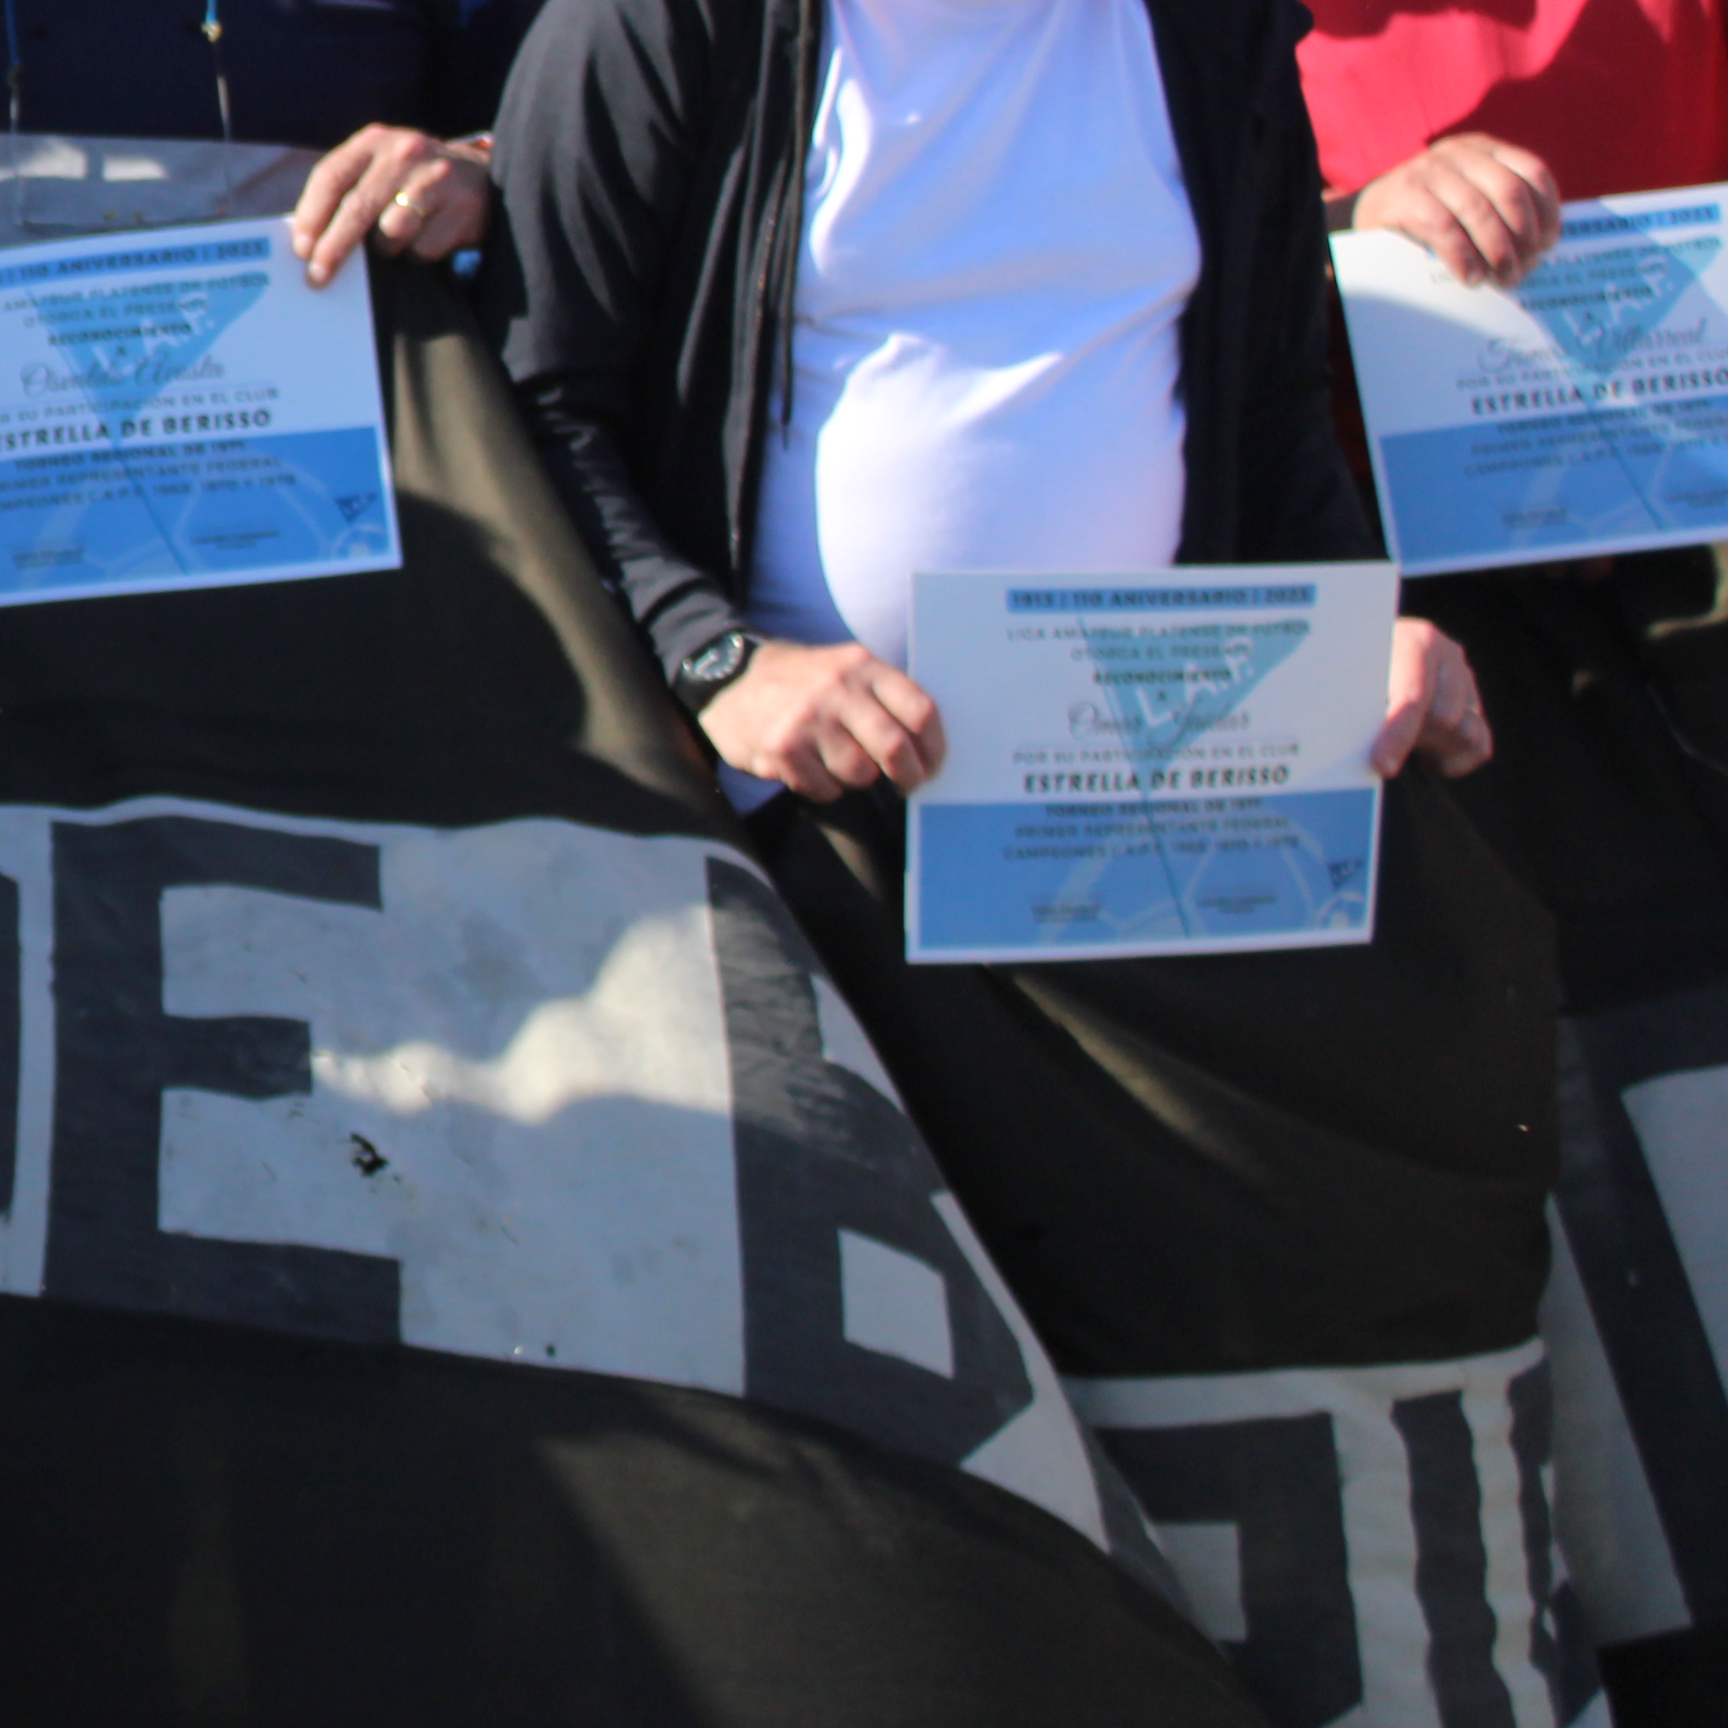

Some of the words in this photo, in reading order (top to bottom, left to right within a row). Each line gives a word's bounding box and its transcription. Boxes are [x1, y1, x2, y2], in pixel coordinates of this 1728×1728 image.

[1471, 384, 1585, 415] ESTRELLA
[1593, 380, 1624, 400] DE
[120, 418, 152, 438] DE
[160, 406, 275, 436] BERISSO
[1025, 771, 1140, 793] ESTRELLA
[1151, 770, 1180, 789] DE
[1188, 765, 1291, 788] BERISSO
